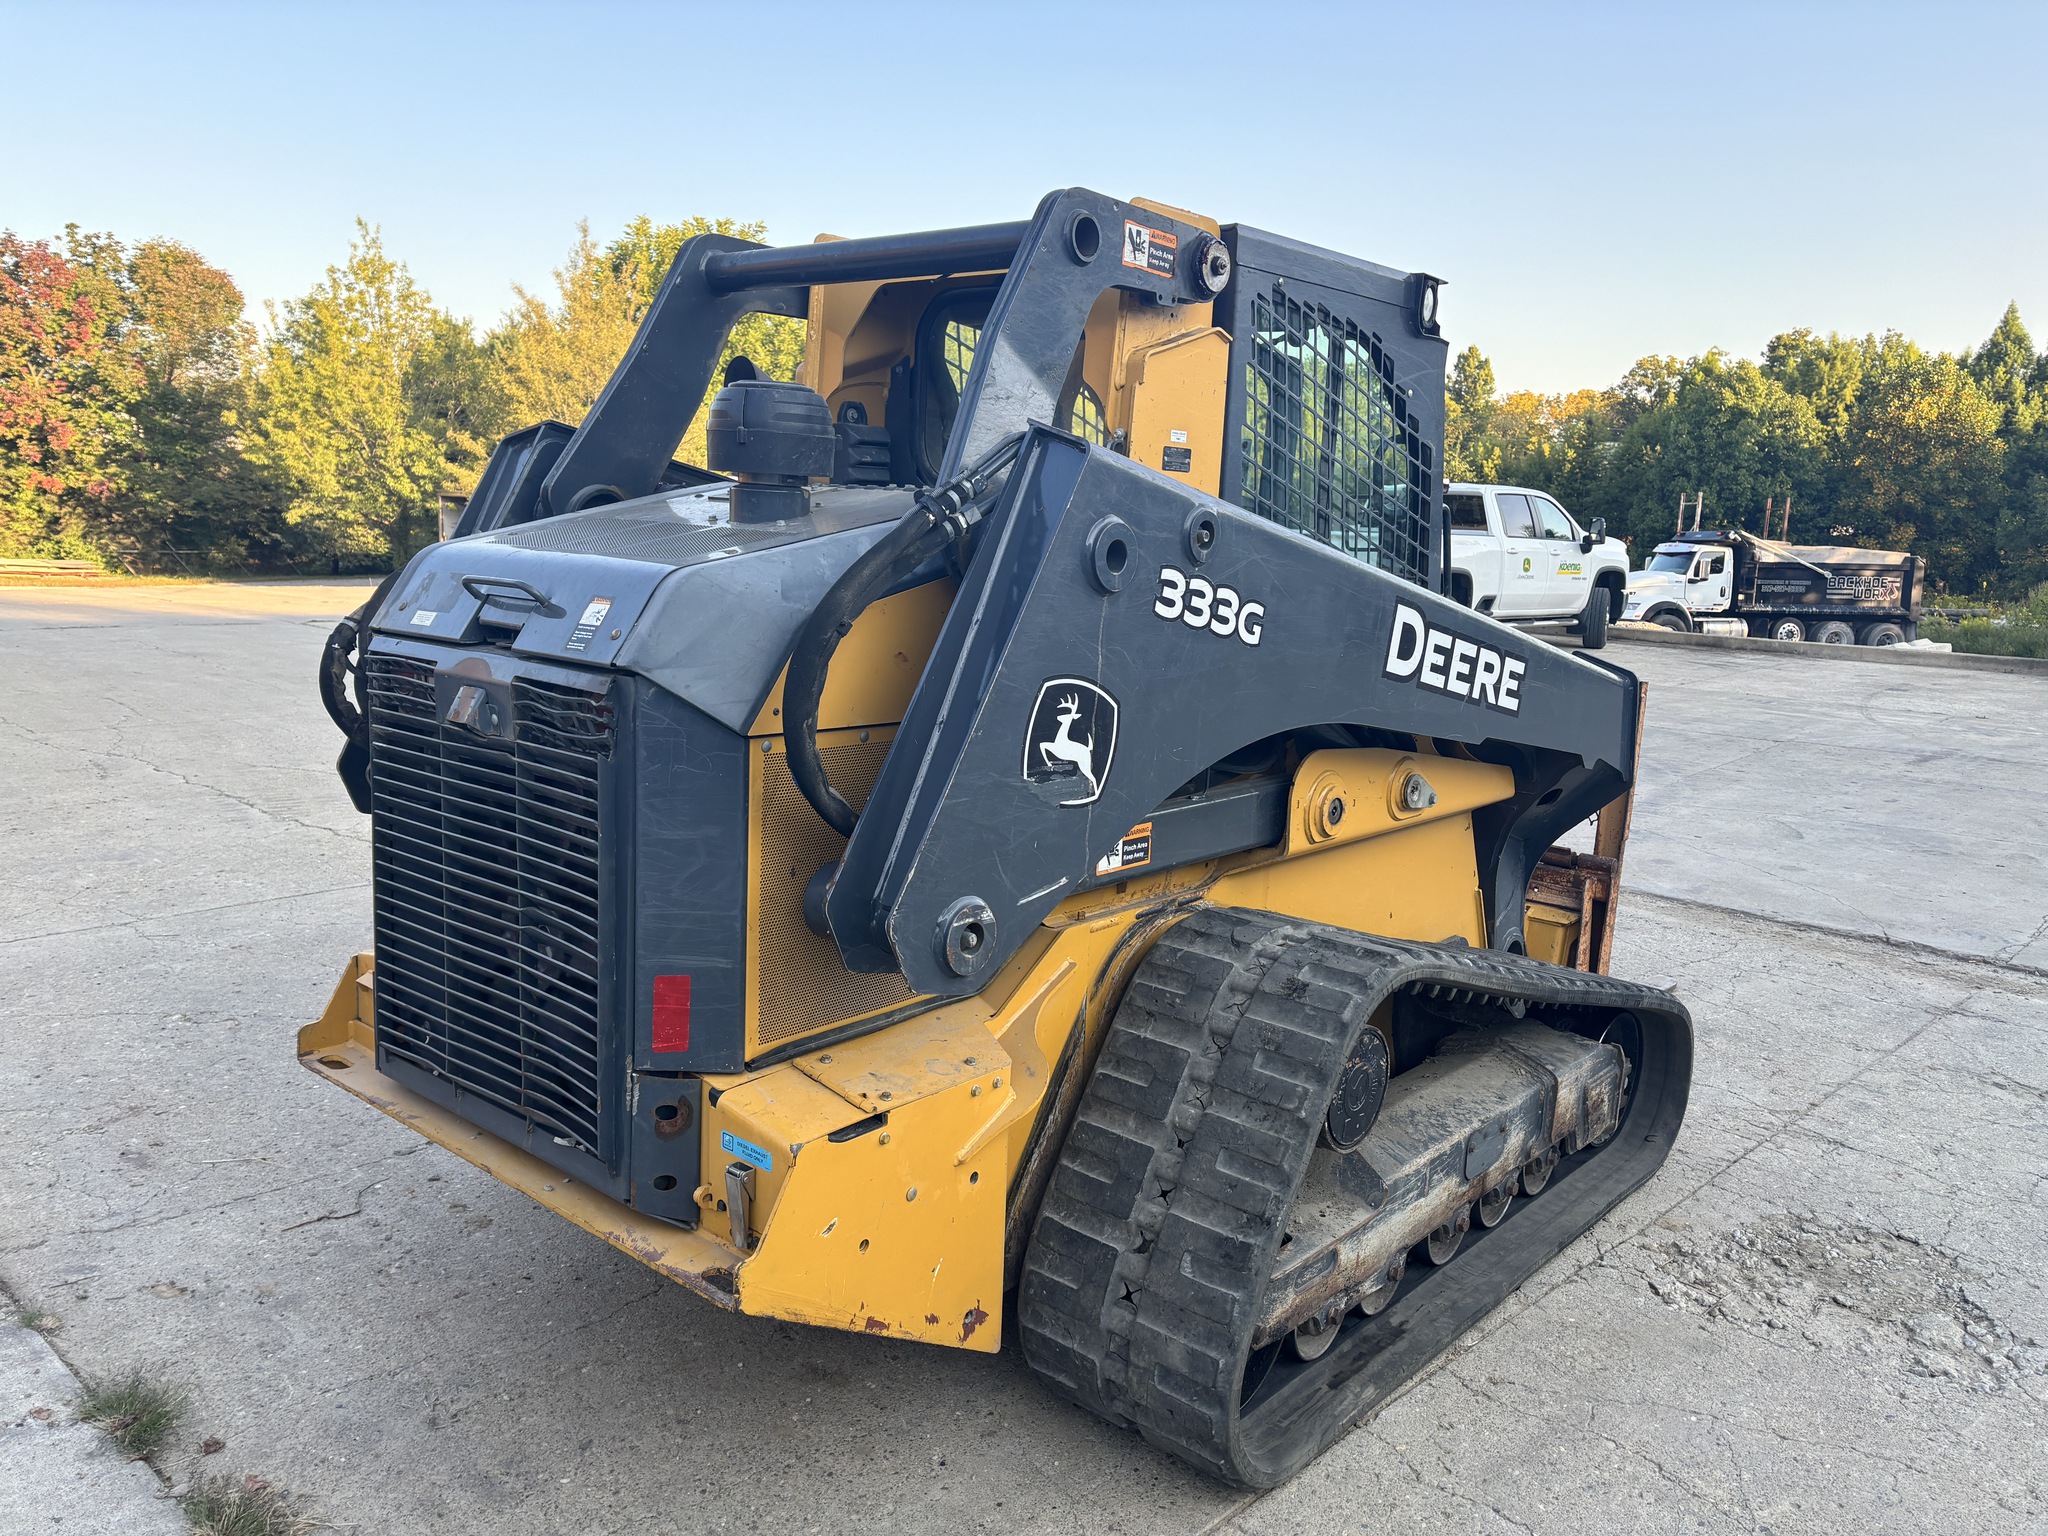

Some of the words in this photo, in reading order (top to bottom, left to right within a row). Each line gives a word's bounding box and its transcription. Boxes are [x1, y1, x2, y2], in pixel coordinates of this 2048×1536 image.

[1149, 247, 1163, 257] Pinch
[1163, 251, 1174, 260] Area
[1149, 257, 1159, 266] Keep
[1827, 576, 1889, 588] BACKHOE
[1853, 587, 1890, 600] WORX
[1154, 568, 1265, 645] 333G
[1385, 603, 1526, 711] DEERE
[1130, 826, 1149, 835] WARNING
[1123, 844, 1136, 852] Pinch
[736, 1141, 750, 1151] DIESEL
[750, 1148, 769, 1159] EXHAUST
[742, 1150, 754, 1159] FLUID
